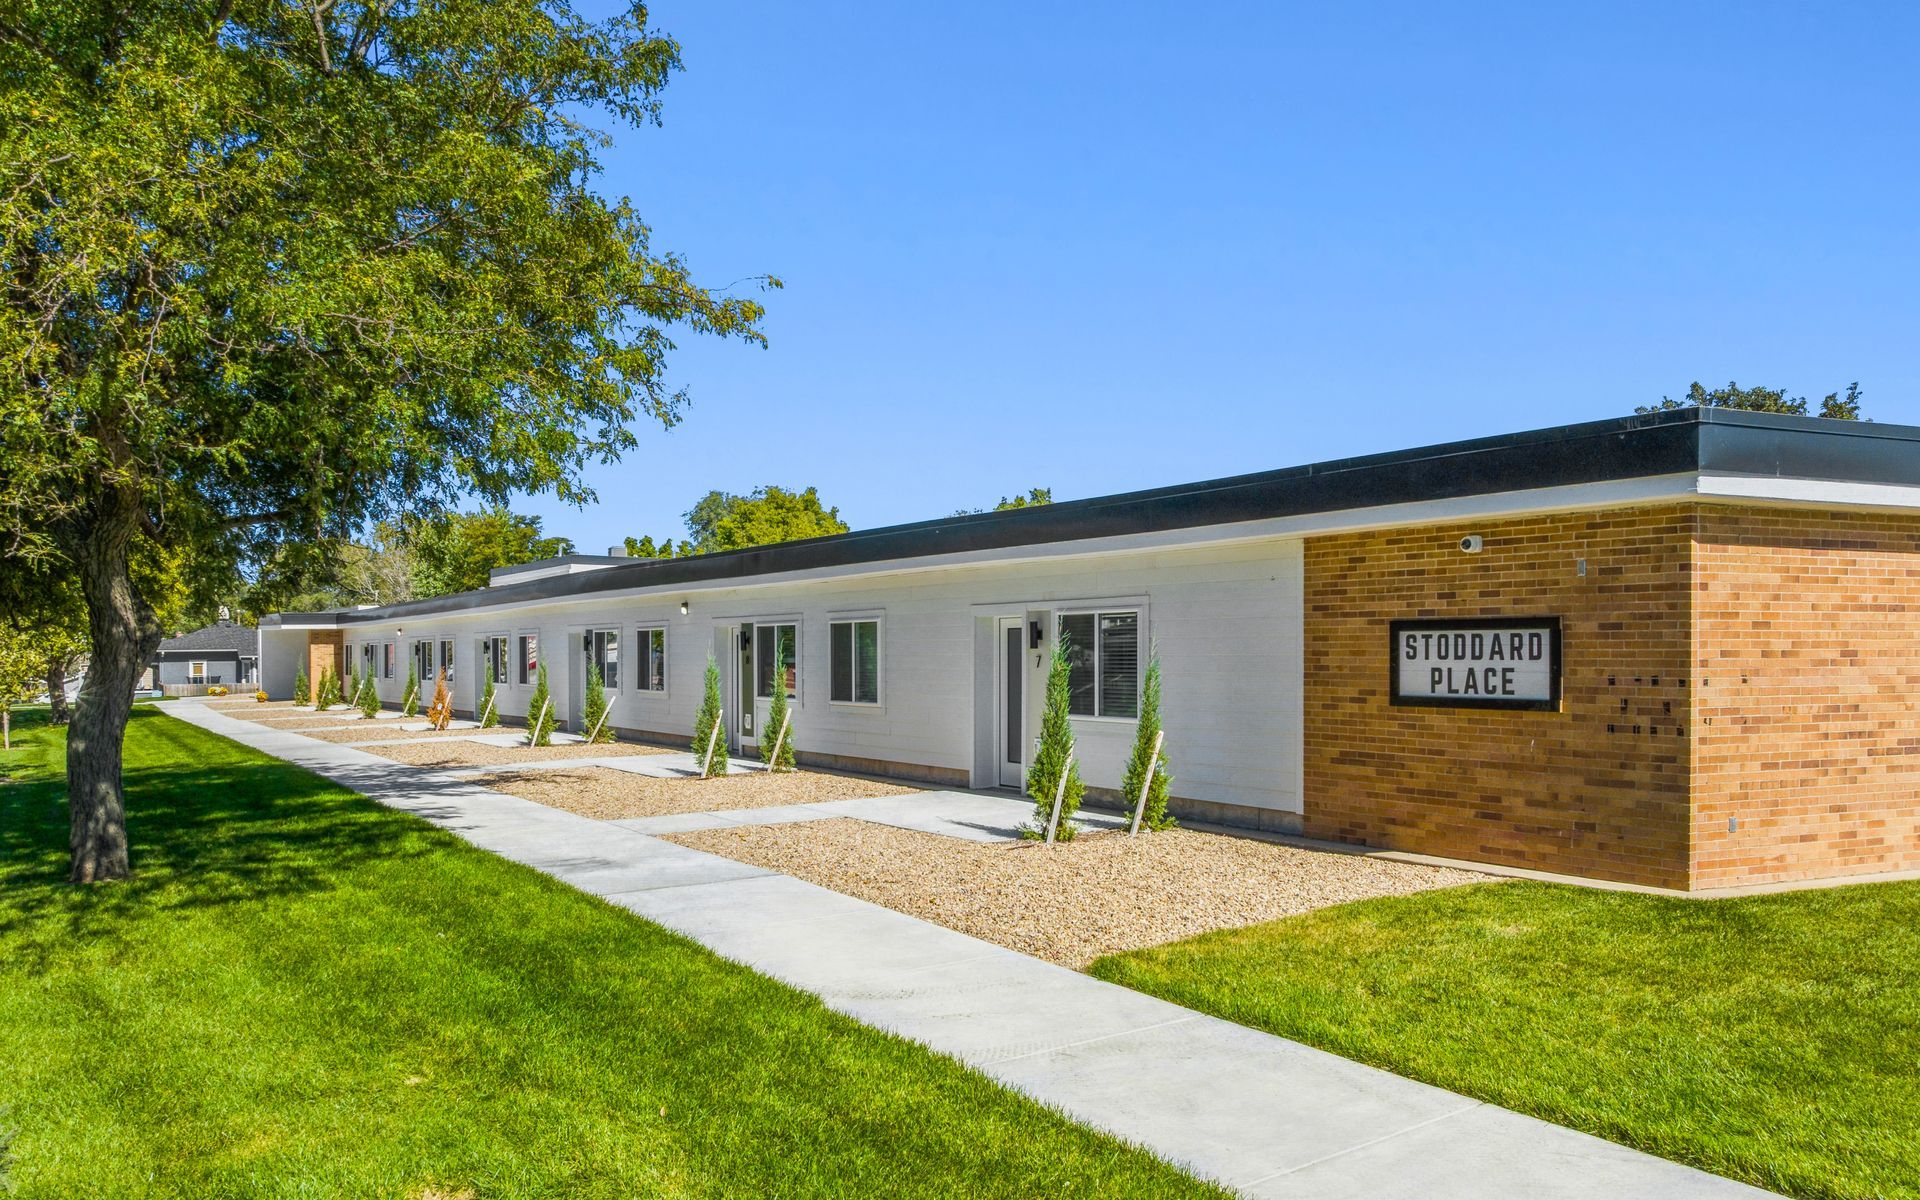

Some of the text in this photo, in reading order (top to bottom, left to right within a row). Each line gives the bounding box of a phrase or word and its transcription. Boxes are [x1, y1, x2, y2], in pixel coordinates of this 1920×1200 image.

[1405, 633, 1543, 661] STODDARD
[1035, 655, 1042, 669] 7
[1430, 667, 1516, 695] PLACE
